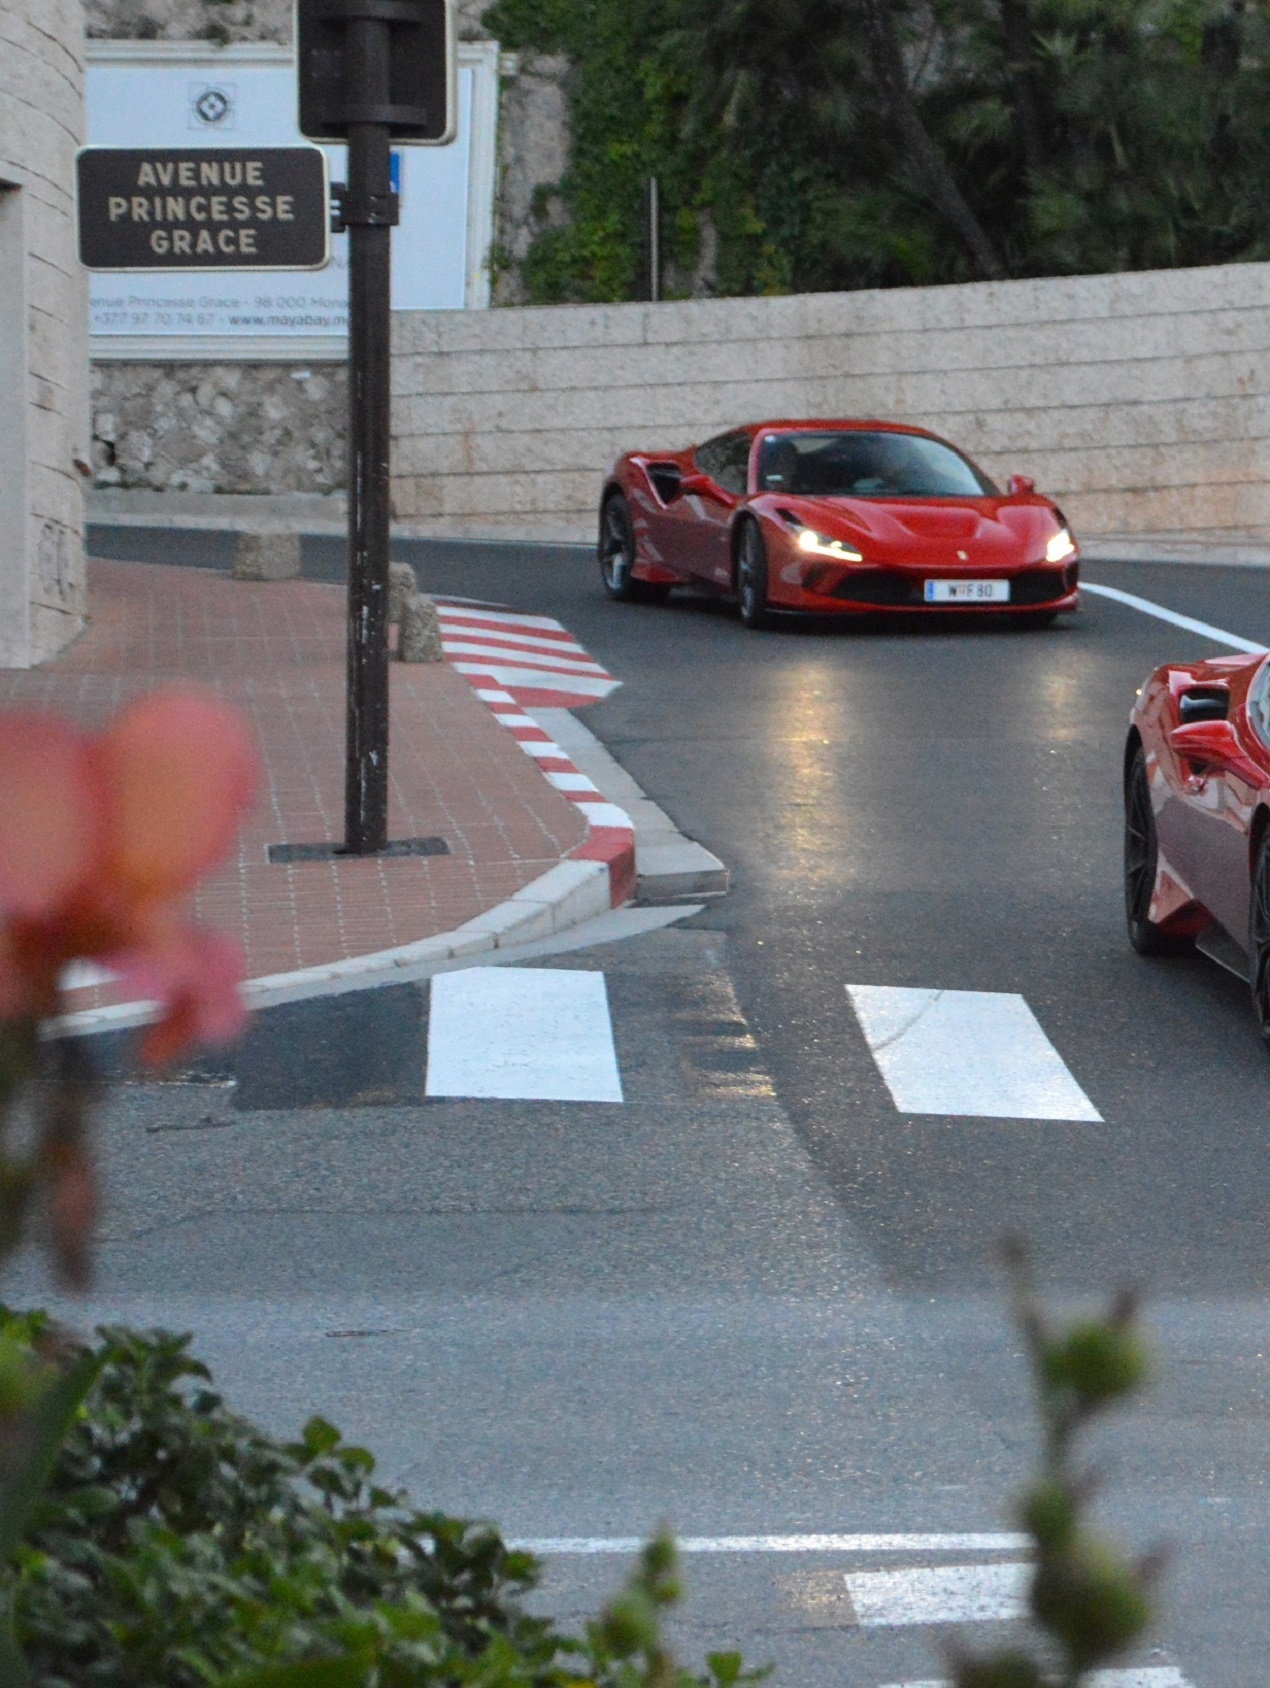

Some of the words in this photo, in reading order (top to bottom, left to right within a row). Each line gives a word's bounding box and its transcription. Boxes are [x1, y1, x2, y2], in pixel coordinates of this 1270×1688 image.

[137, 161, 265, 187] AVENUE
[108, 195, 295, 222] PRINCESSE
[150, 228, 259, 255] GRACE
[89, 297, 123, 308] enue
[127, 295, 195, 308] Princesse
[198, 295, 239, 308] Grace
[310, 296, 348, 308] Mona
[228, 315, 348, 328] www.mayabay.m
